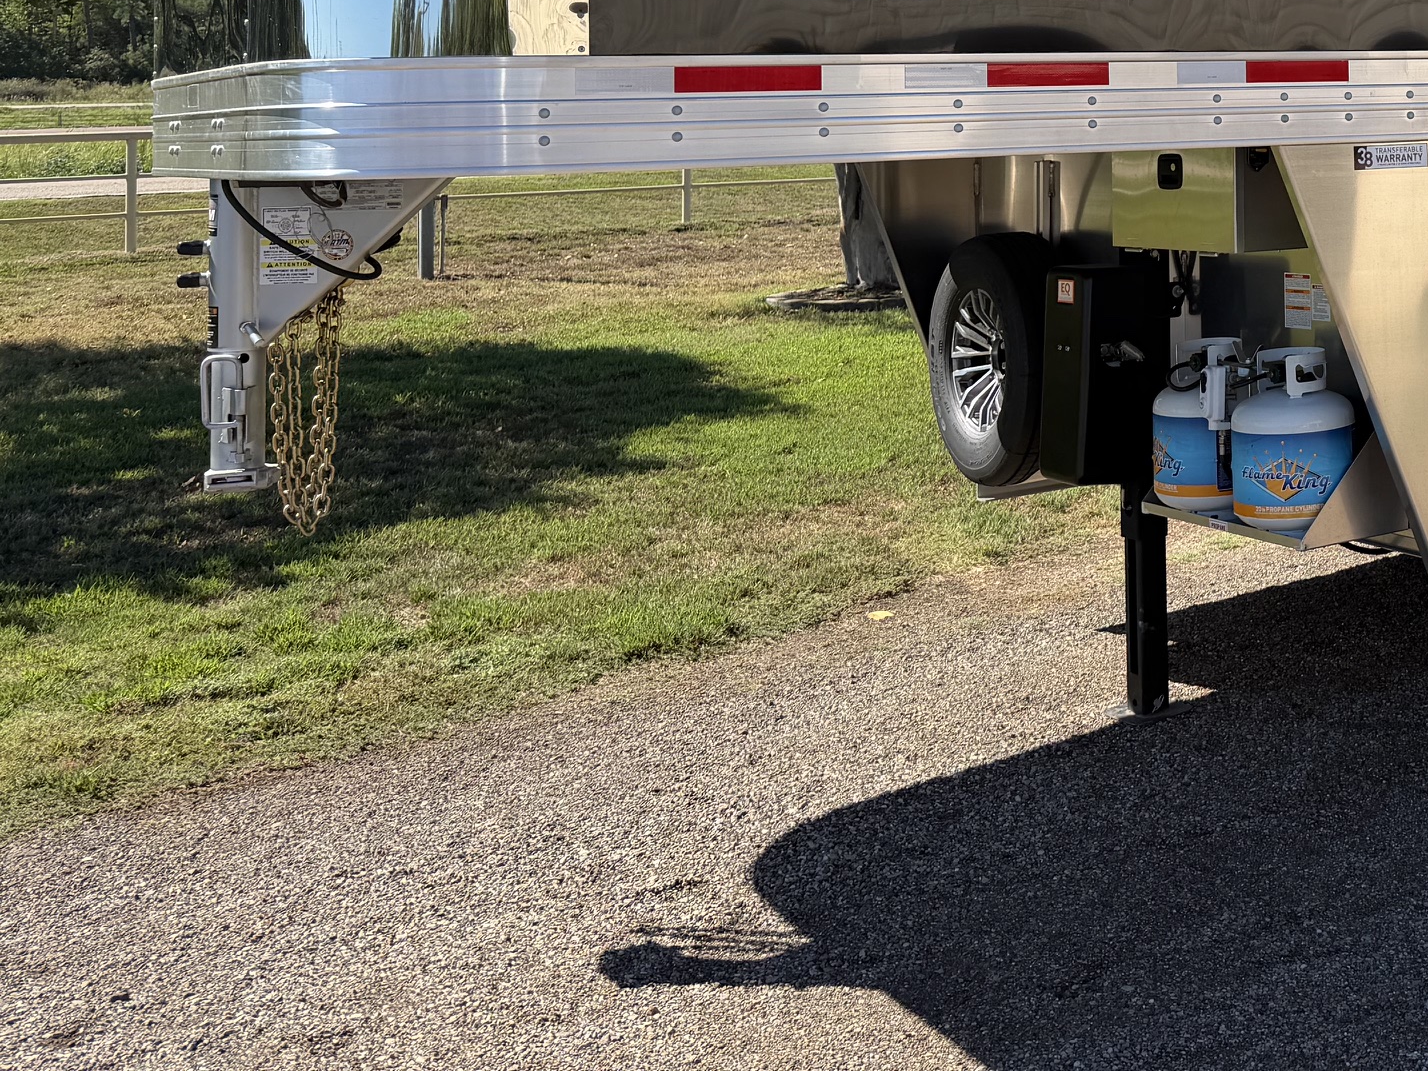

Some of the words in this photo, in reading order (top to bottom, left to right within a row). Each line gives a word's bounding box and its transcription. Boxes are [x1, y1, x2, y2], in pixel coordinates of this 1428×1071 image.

[1375, 146, 1423, 155] TRANSFERABLE
[1357, 147, 1373, 167] 38
[1375, 153, 1423, 163] WARRANTY
[274, 261, 312, 269] ATTENTION
[1060, 282, 1071, 296] EQ
[1281, 472, 1331, 496] King
